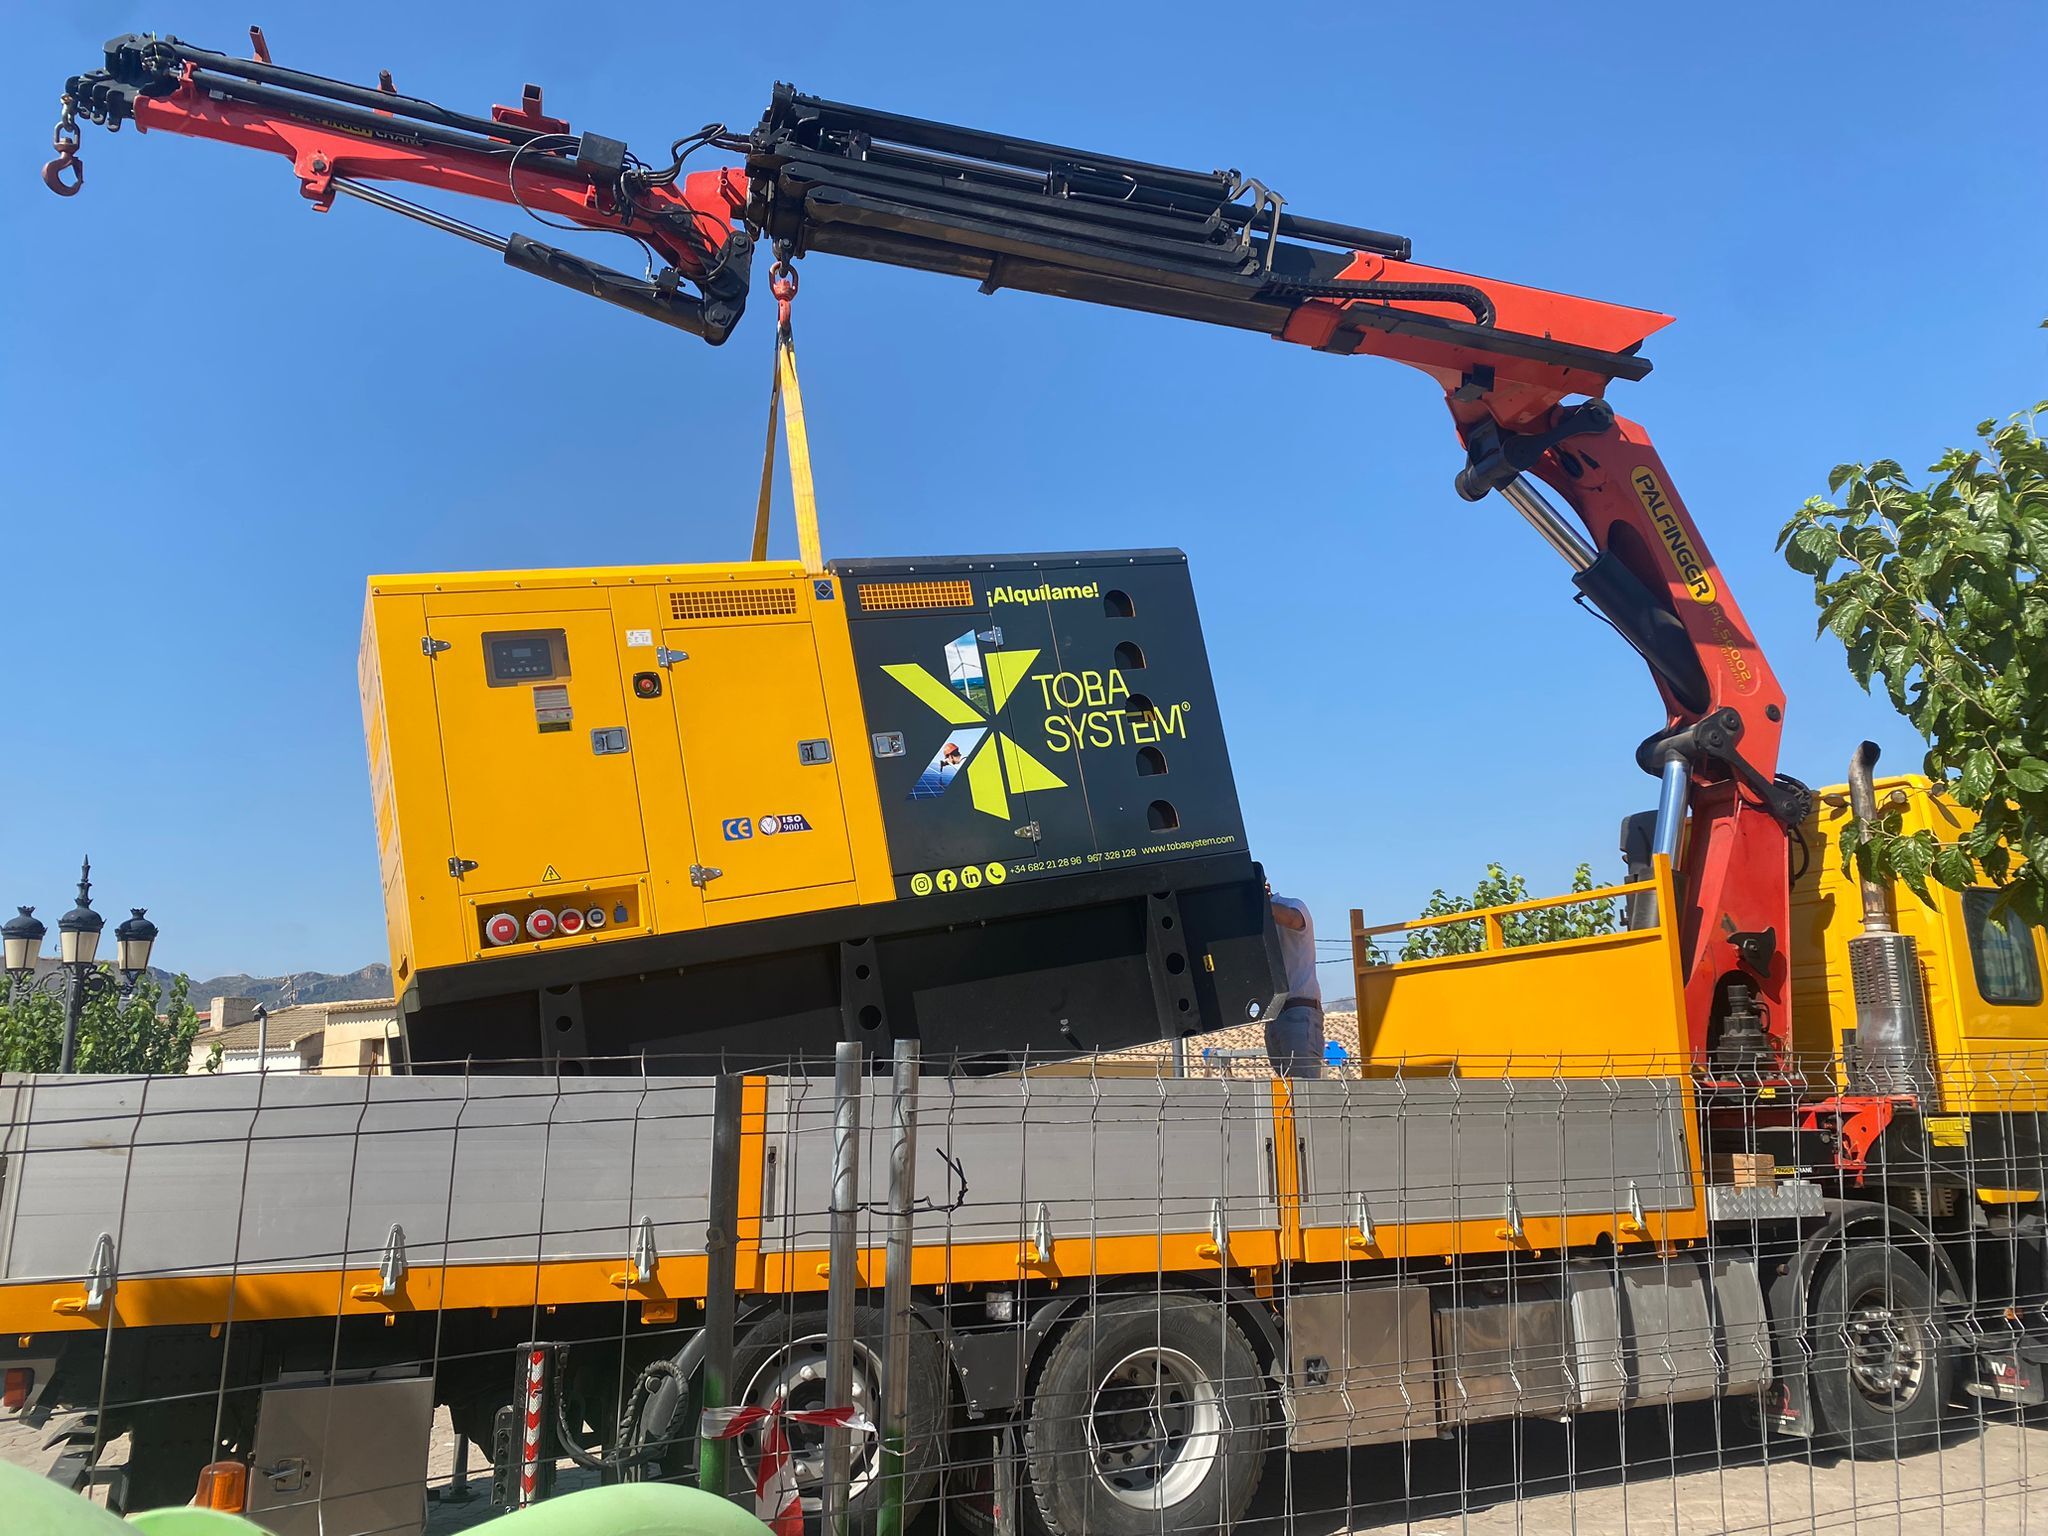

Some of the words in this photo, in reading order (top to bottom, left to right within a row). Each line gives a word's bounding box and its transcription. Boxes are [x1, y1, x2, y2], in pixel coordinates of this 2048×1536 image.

[1635, 473, 1710, 598] PALFINGER
[986, 581, 1100, 608] ¡Alquílame!
[1031, 668, 1131, 711] TOBA
[726, 819, 751, 839] CE
[782, 815, 802, 823] ISO
[783, 823, 804, 832] 9001
[1010, 864, 1026, 874] +34
[1028, 862, 1045, 872] 682
[1046, 859, 1057, 869] 21
[1058, 857, 1070, 868] 28
[1070, 856, 1082, 866] 96
[1087, 853, 1102, 863] 967
[1104, 850, 1121, 860] 328
[1122, 848, 1137, 858] 128
[1141, 834, 1235, 855] www.tobasystem.com
